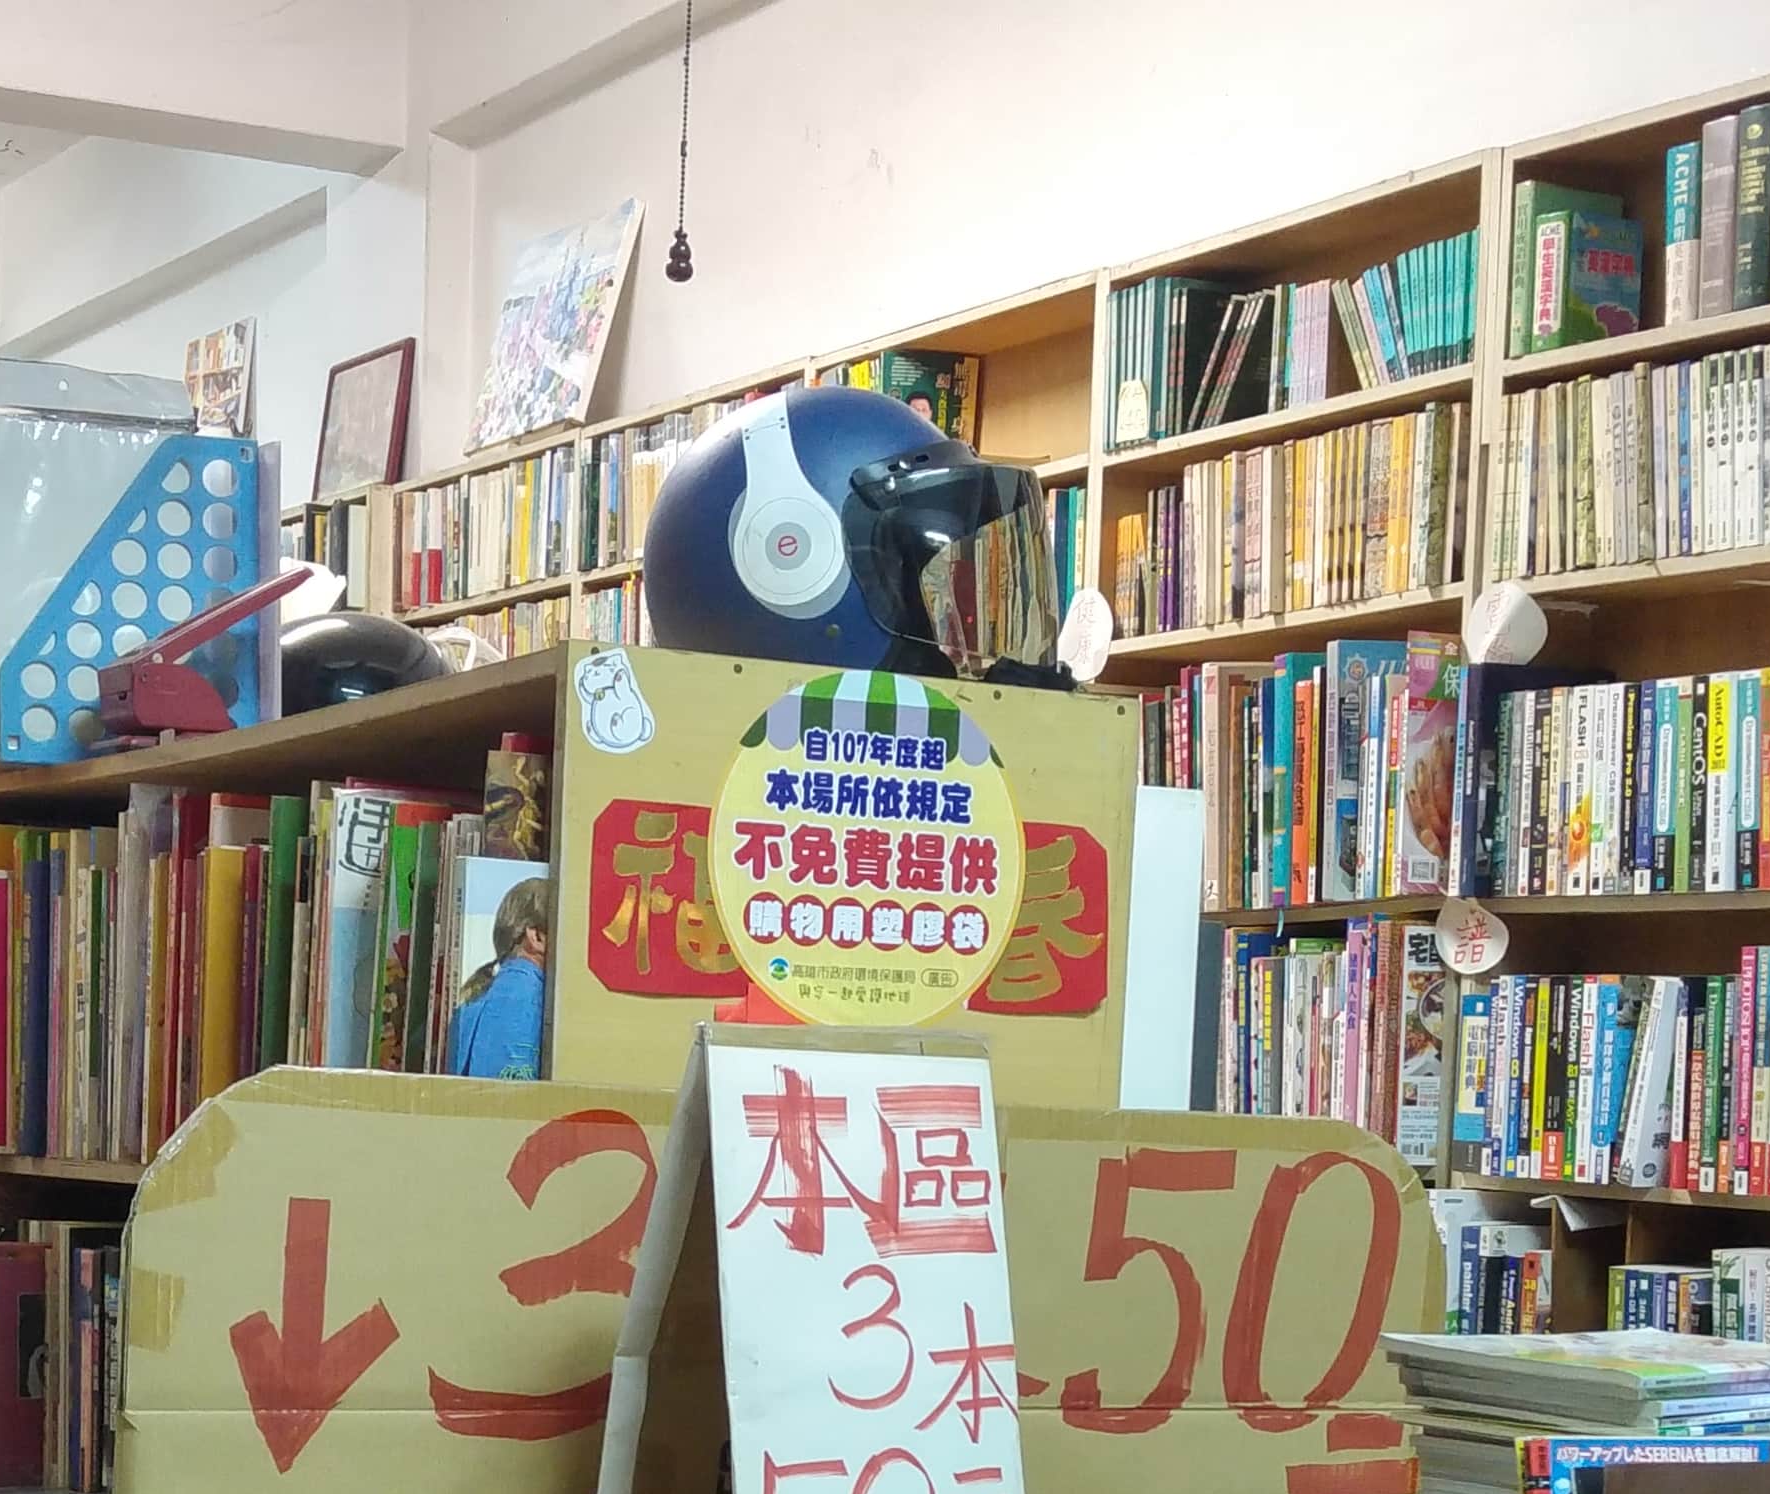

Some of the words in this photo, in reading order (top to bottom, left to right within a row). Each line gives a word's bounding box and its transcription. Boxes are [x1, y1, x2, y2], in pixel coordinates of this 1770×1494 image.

[1673, 152, 1690, 212] ACME
[1540, 224, 1562, 236] ACME
[804, 729, 946, 771] 自107年度起
[1577, 695, 1588, 747] FLASH
[1610, 692, 1619, 766] Dreamweaver
[1693, 712, 1706, 785] CentOS
[1714, 685, 1726, 758] AutoCAD
[766, 770, 972, 824] 本場所依規定
[734, 821, 998, 895] 不免費提供
[747, 898, 985, 950] 購物用塑膠袋
[791, 964, 916, 984] 高雄市政府環境保護局
[1498, 994, 1508, 1046] Flash
[1512, 985, 1524, 1058] Windows
[1569, 987, 1581, 1062] Windows
[1581, 1012, 1595, 1066] Flash
[1740, 966, 1754, 1052] PHOTOSHOP
[726, 1063, 997, 1259] 本區
[1062, 1147, 1403, 1434] 50
[1460, 1261, 1472, 1312] painter
[827, 1264, 1021, 1445] 3本
